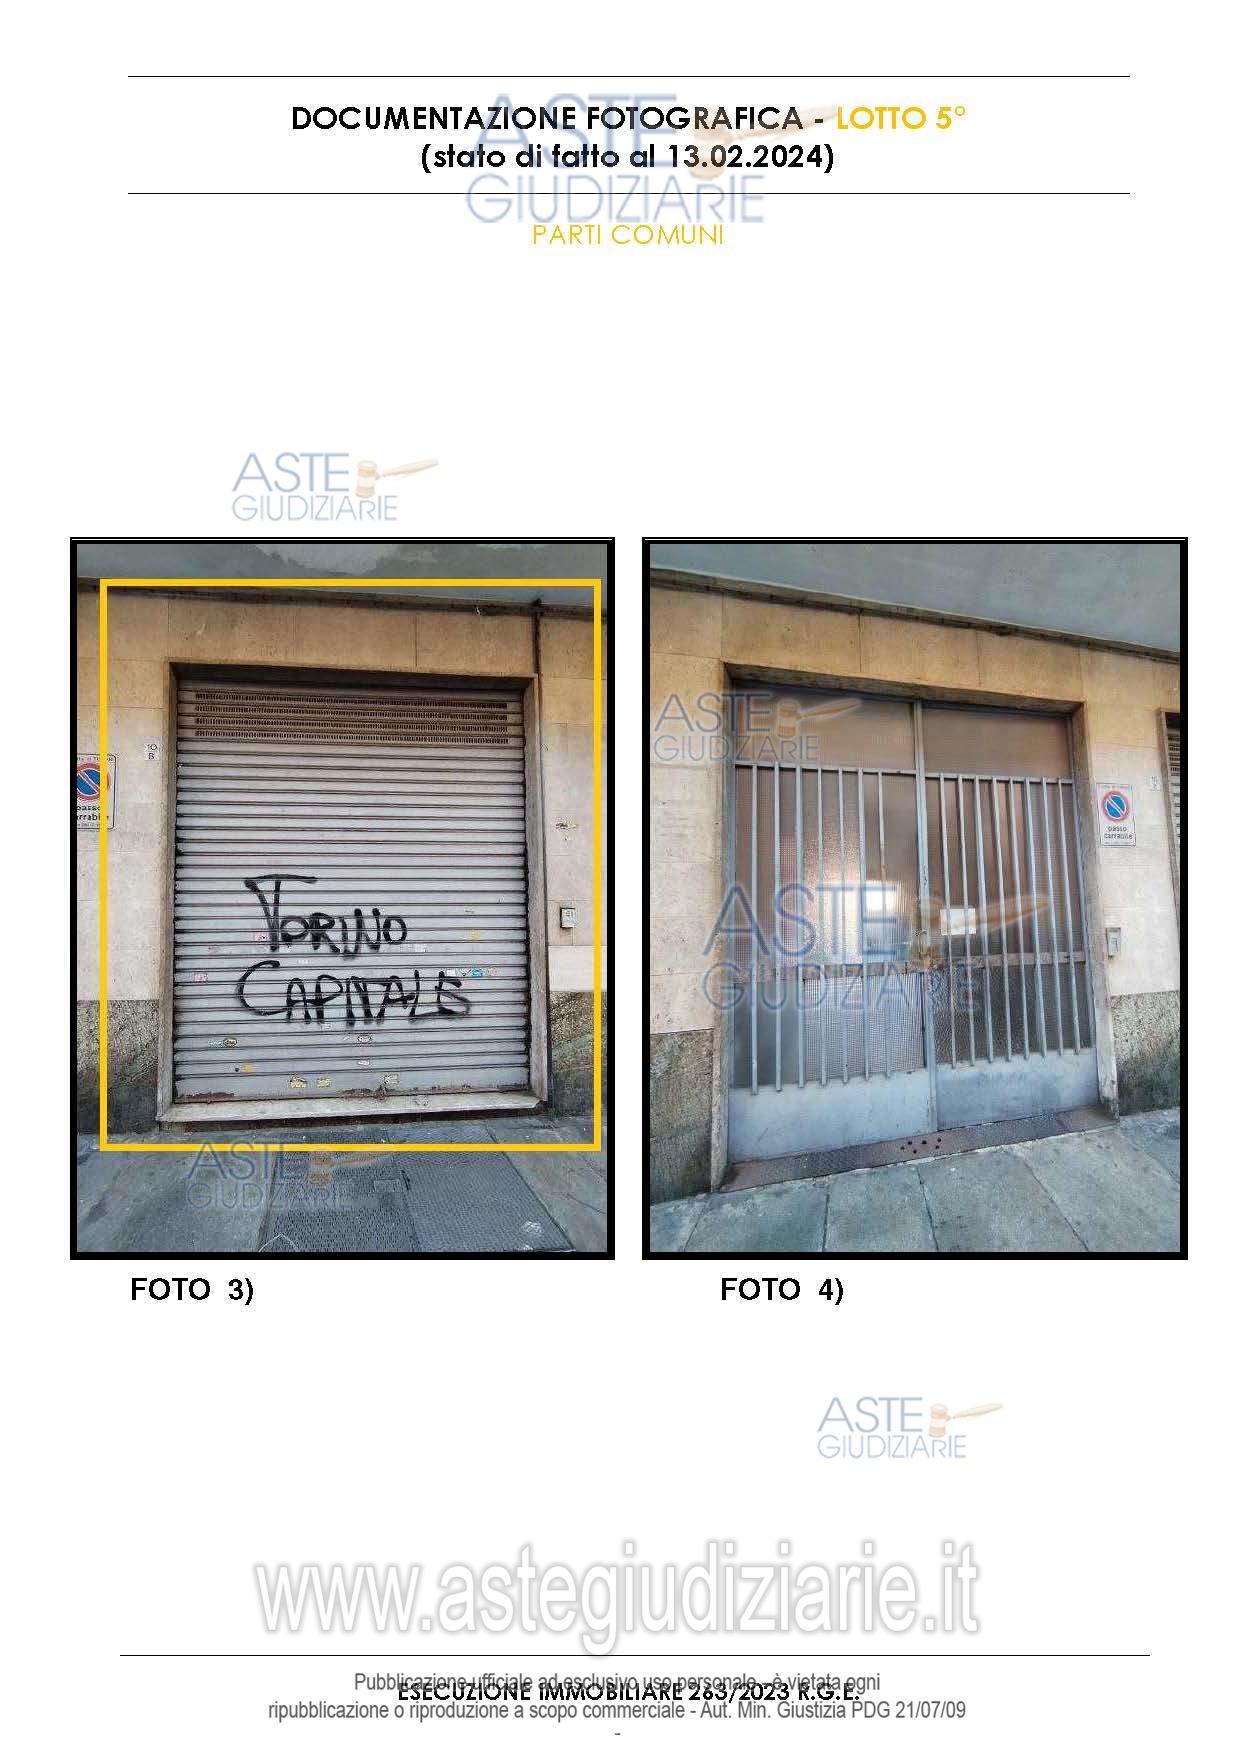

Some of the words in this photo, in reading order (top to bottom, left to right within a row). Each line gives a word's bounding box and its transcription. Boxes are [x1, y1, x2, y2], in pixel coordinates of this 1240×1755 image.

[292, 106, 576, 130] DOCUMENTAZIONE
[587, 106, 804, 130] FOTOGRAFICA
[837, 106, 927, 130] LOTTO
[936, 106, 966, 130] 5°
[421, 144, 506, 173] (stato
[515, 144, 542, 168] di
[551, 144, 620, 168] fatto
[629, 144, 655, 168] al
[668, 144, 834, 173] 13.02.2024)
[533, 224, 601, 245] PARTI
[611, 224, 724, 245] COMUNI
[131, 1277, 211, 1301] FOTO
[228, 1277, 254, 1306] 3)
[721, 1277, 801, 1301] FOTO
[818, 1277, 844, 1306] 4)
[398, 1683, 531, 1701] ESECUZIONE
[539, 1683, 683, 1701] IMMOBILIARE
[688, 1683, 790, 1704] 263/2023
[798, 1683, 860, 1701] R.G.E.
